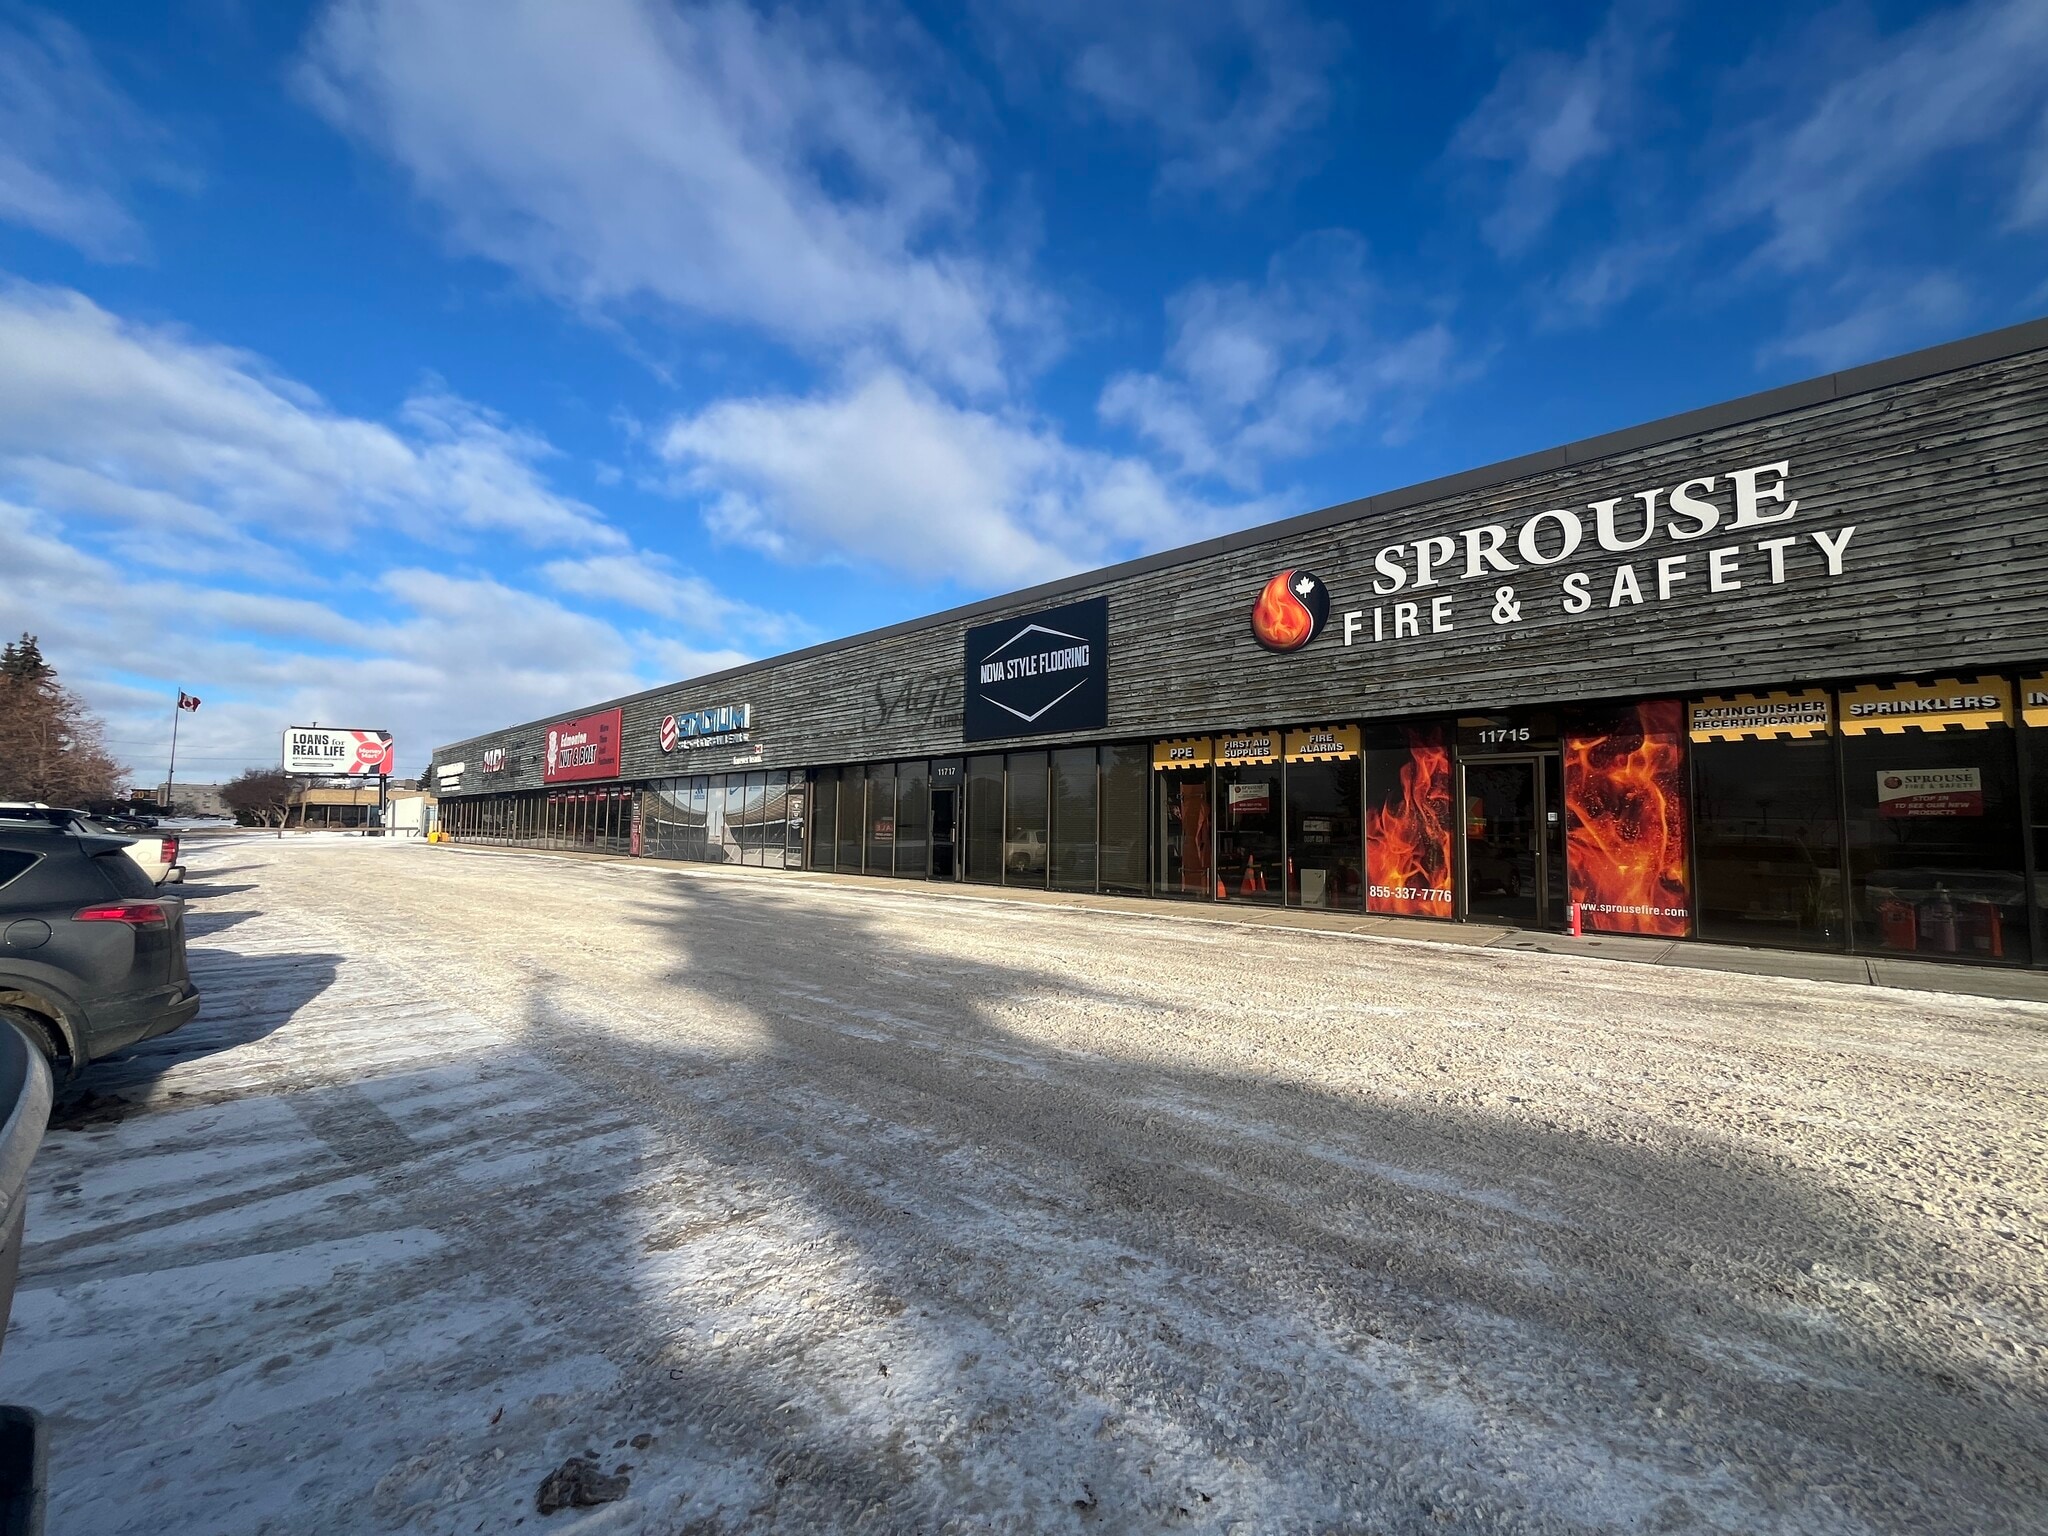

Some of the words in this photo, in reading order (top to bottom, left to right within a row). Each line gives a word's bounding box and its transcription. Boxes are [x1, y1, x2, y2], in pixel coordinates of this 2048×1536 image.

[1372, 459, 1799, 596] SPROUSE
[1343, 595, 1455, 647] FIRE
[1490, 585, 1523, 625] &
[1561, 525, 1857, 615] SAFETY
[980, 661, 1005, 684] NOVA
[1007, 654, 1038, 680] STYLE
[1039, 644, 1090, 674] FLOORING
[1693, 700, 1826, 720] EXTINGUISHER
[1849, 694, 1998, 716] SPRINKLERS
[1692, 712, 1828, 730] RECERTIFICATION
[293, 733, 329, 745] LOANS
[331, 738, 345, 746] for
[560, 731, 587, 748] Edmonton
[1224, 740, 1250, 750] FIRST
[1253, 738, 1270, 748] AID
[1309, 733, 1334, 744] FIRE
[1478, 727, 1531, 744] 11715
[292, 745, 320, 756] REAL
[323, 746, 345, 757] LIFE
[559, 748, 572, 768] NUT
[578, 743, 598, 766] BOLT
[1170, 747, 1193, 759] PPE
[1224, 748, 1270, 758] SUPPLIES
[1299, 742, 1344, 754] ALARMS
[937, 767, 956, 776] 11717
[1905, 774, 1973, 784] SPROUSE
[1940, 782, 1974, 790] SAFETY
[1369, 885, 1453, 903] 855-337-7776
[1580, 901, 1689, 918] ww.sprousefire.com
